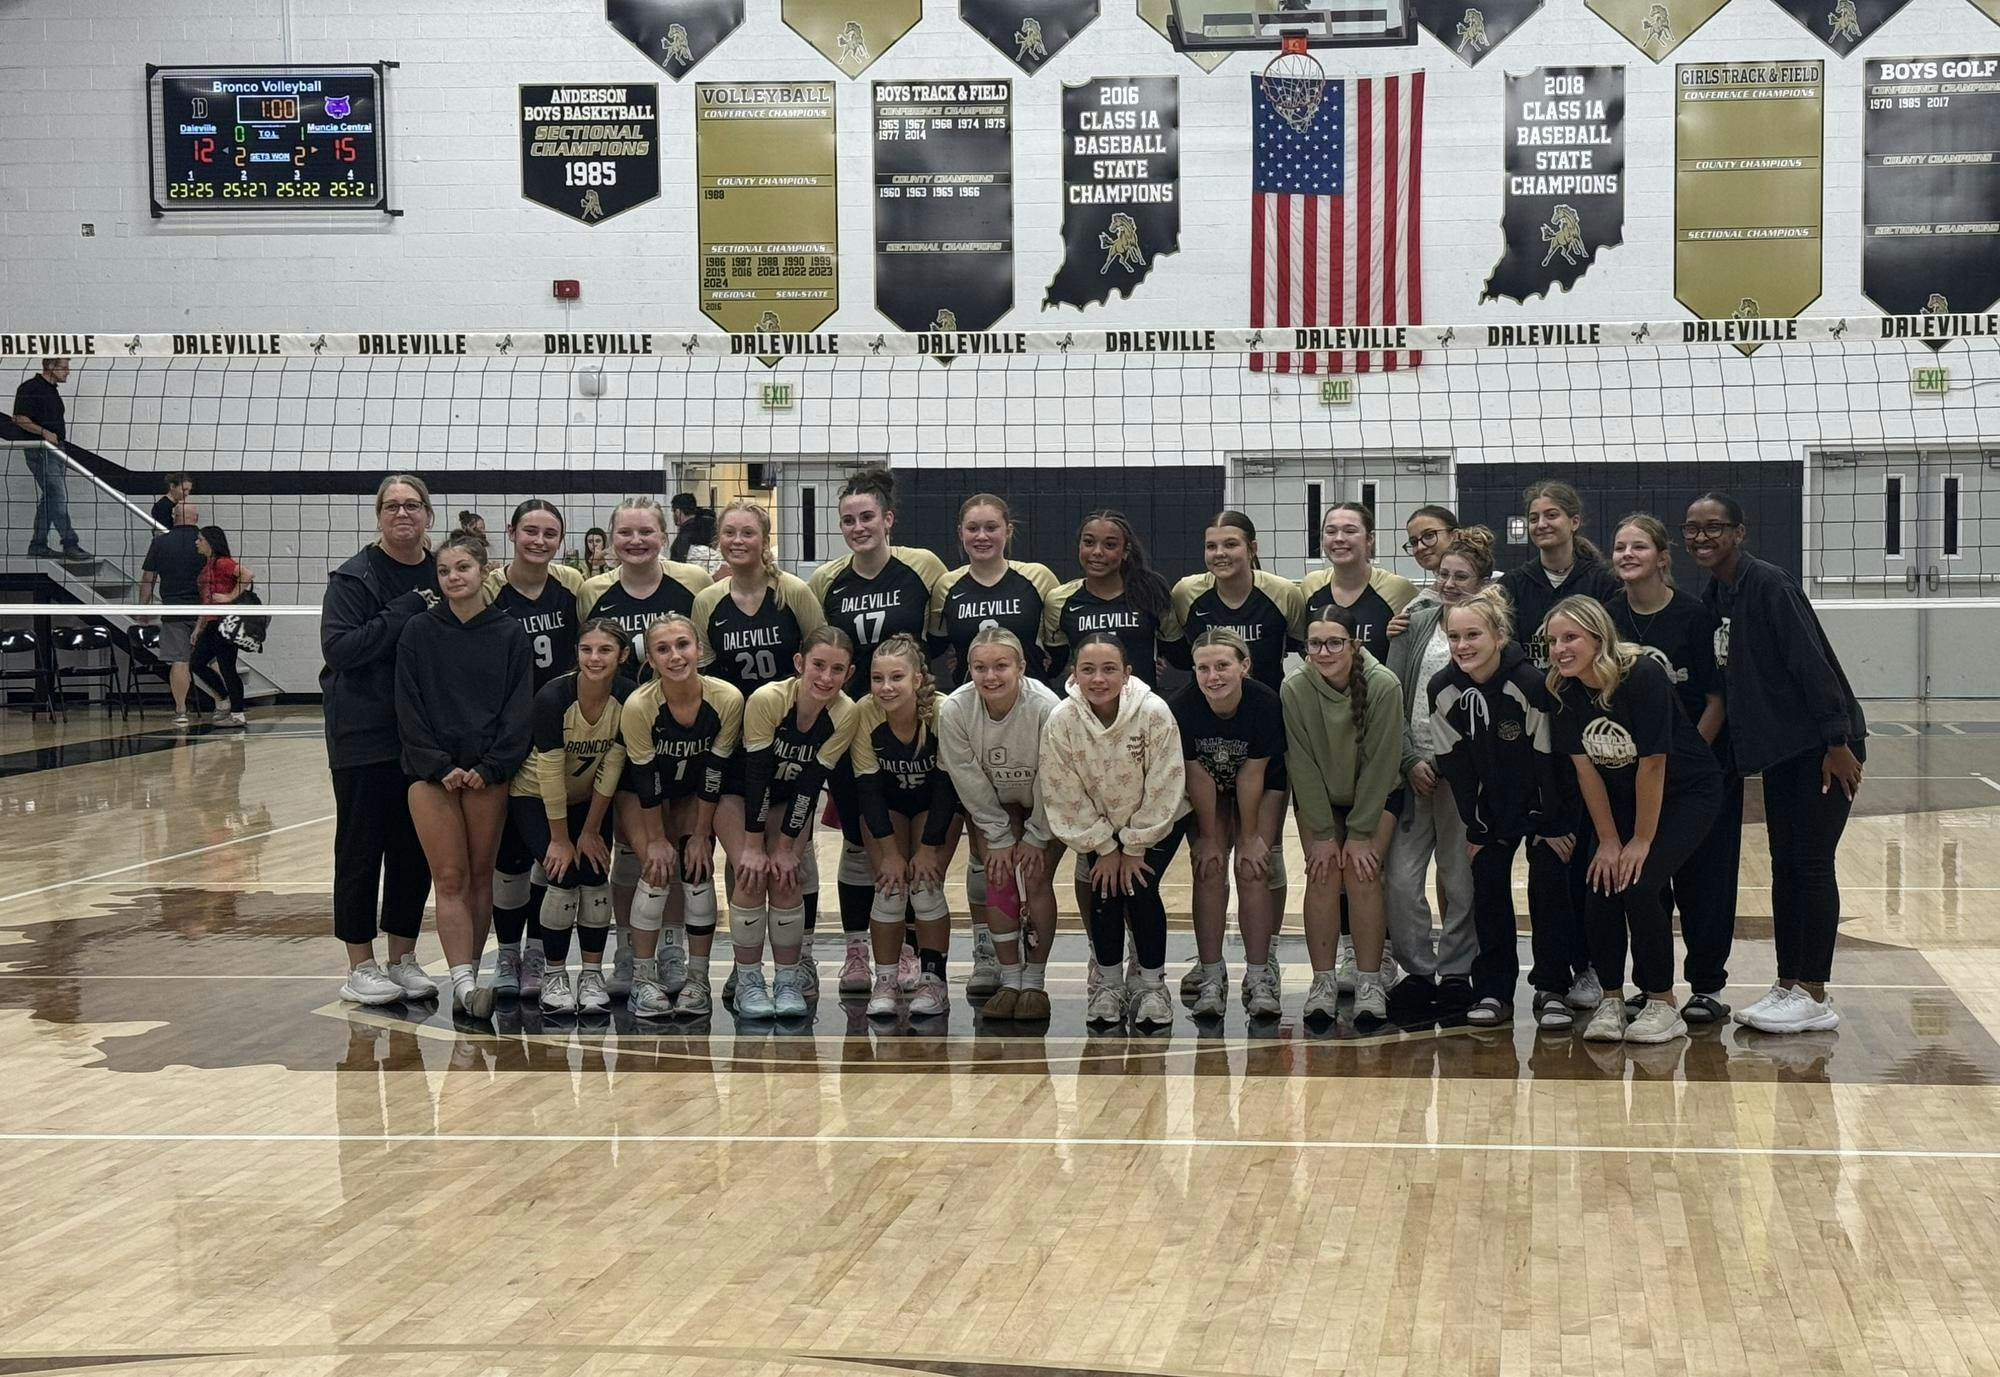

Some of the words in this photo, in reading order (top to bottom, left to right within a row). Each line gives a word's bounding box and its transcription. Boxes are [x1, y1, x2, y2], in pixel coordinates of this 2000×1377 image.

[1681, 69, 1720, 85] GIRLS
[1722, 67, 1767, 84] TRACK
[1769, 67, 1778, 83] &
[1781, 66, 1819, 82] FIELD
[1880, 62, 1938, 80] BOYS
[1942, 60, 1998, 78] GOLF
[213, 81, 258, 92] Bronco
[261, 80, 321, 94] Volleyball
[876, 86, 910, 102] BOYS
[912, 85, 956, 101] TRACK
[957, 85, 968, 100] &
[969, 85, 1008, 100] FIELD
[1544, 75, 1584, 95] 2018
[1684, 90, 1750, 100] CONFERENCE
[1752, 88, 1815, 98] CHAMPIONS
[550, 89, 627, 104] ANDERSON
[701, 88, 830, 104] VOLLEYBALL
[1100, 86, 1139, 105] 2016
[1869, 99, 1893, 109] 1970
[1898, 98, 1921, 109] 1985
[1927, 97, 1950, 108] 2017
[261, 99, 295, 119] 1:00
[524, 106, 561, 121] BOYS
[563, 105, 654, 120] BASKETBALL
[768, 109, 827, 117] CHAMPIONS
[1523, 100, 1580, 120] CLASS
[1585, 100, 1605, 120] 1A
[307, 123, 339, 132] Muncie
[340, 122, 372, 132] Central
[957, 119, 980, 129] 1974
[984, 118, 1006, 129] 1975
[1080, 111, 1136, 130] CLASS
[1141, 110, 1160, 129] 1A
[234, 125, 245, 143] 0
[535, 125, 643, 140] SECTIONAL
[878, 130, 900, 140] 1977
[904, 130, 927, 140] 2014
[1517, 125, 1612, 146] BASEBALL
[194, 138, 215, 162] 12
[335, 137, 356, 161] 15
[530, 141, 649, 157] CHAMPIONS
[1074, 135, 1167, 155] BASEBALL
[235, 147, 247, 166] 2
[294, 146, 306, 166] 2
[1536, 150, 1592, 170] STATE
[1695, 161, 1737, 169] COUNTY
[1739, 159, 1802, 168] CHAMPIONS
[187, 170, 195, 181] 1
[240, 170, 247, 180] 2
[347, 169, 354, 180] 4
[565, 161, 617, 186] 1985
[1093, 159, 1149, 179] STATE
[170, 183, 214, 198] 23:25
[223, 182, 267, 198] 25:27
[276, 182, 320, 197] 25:22
[329, 182, 374, 197] 25:21
[717, 177, 756, 186] COUNTY
[758, 176, 817, 185] CHAMPIONS
[1511, 175, 1617, 195] CHAMPIONS
[1069, 184, 1173, 204] CHAMPIONS
[1687, 230, 1744, 239] SECTIONAL
[1746, 228, 1809, 238] CHAMPIONS
[711, 244, 763, 253] SECTIONAL
[766, 244, 826, 253] CHAMPIONS
[705, 267, 726, 277] 2015
[731, 267, 752, 277] 2016
[757, 267, 780, 276] 2021
[782, 267, 806, 276] 2022
[808, 267, 833, 276] 2023
[703, 278, 728, 288] 2024
[173, 334, 281, 355] DALEVILLE
[358, 334, 467, 355] DALEVILLE
[544, 334, 653, 354] DALEVILLE
[731, 334, 839, 355] DALEVILLE
[917, 333, 1026, 355] DALEVILLE
[1105, 330, 1216, 352] DALEVILLE
[1295, 327, 1407, 349] DALEVILLE
[1487, 324, 1601, 347] DALEVILLE
[1683, 319, 1797, 342] DALEVILLE
[1881, 314, 1998, 338] DALEVILLE
[1918, 371, 1946, 391] EXIT
[764, 385, 790, 407] EXIT
[1322, 381, 1350, 402] EXIT
[841, 589, 901, 613] DALEVILLE
[958, 599, 1021, 619] DALEVILLE
[853, 611, 886, 645] 17
[1078, 612, 1140, 631] DALEVILLE
[724, 626, 782, 651] DALEVILLE
[533, 634, 553, 668] 9
[735, 650, 777, 680] 20
[566, 738, 614, 755] BRONCOS
[655, 736, 711, 757] DALEVILLE
[572, 756, 597, 777] 7
[674, 759, 688, 781] 1
[789, 794, 811, 830] BRONCOS
